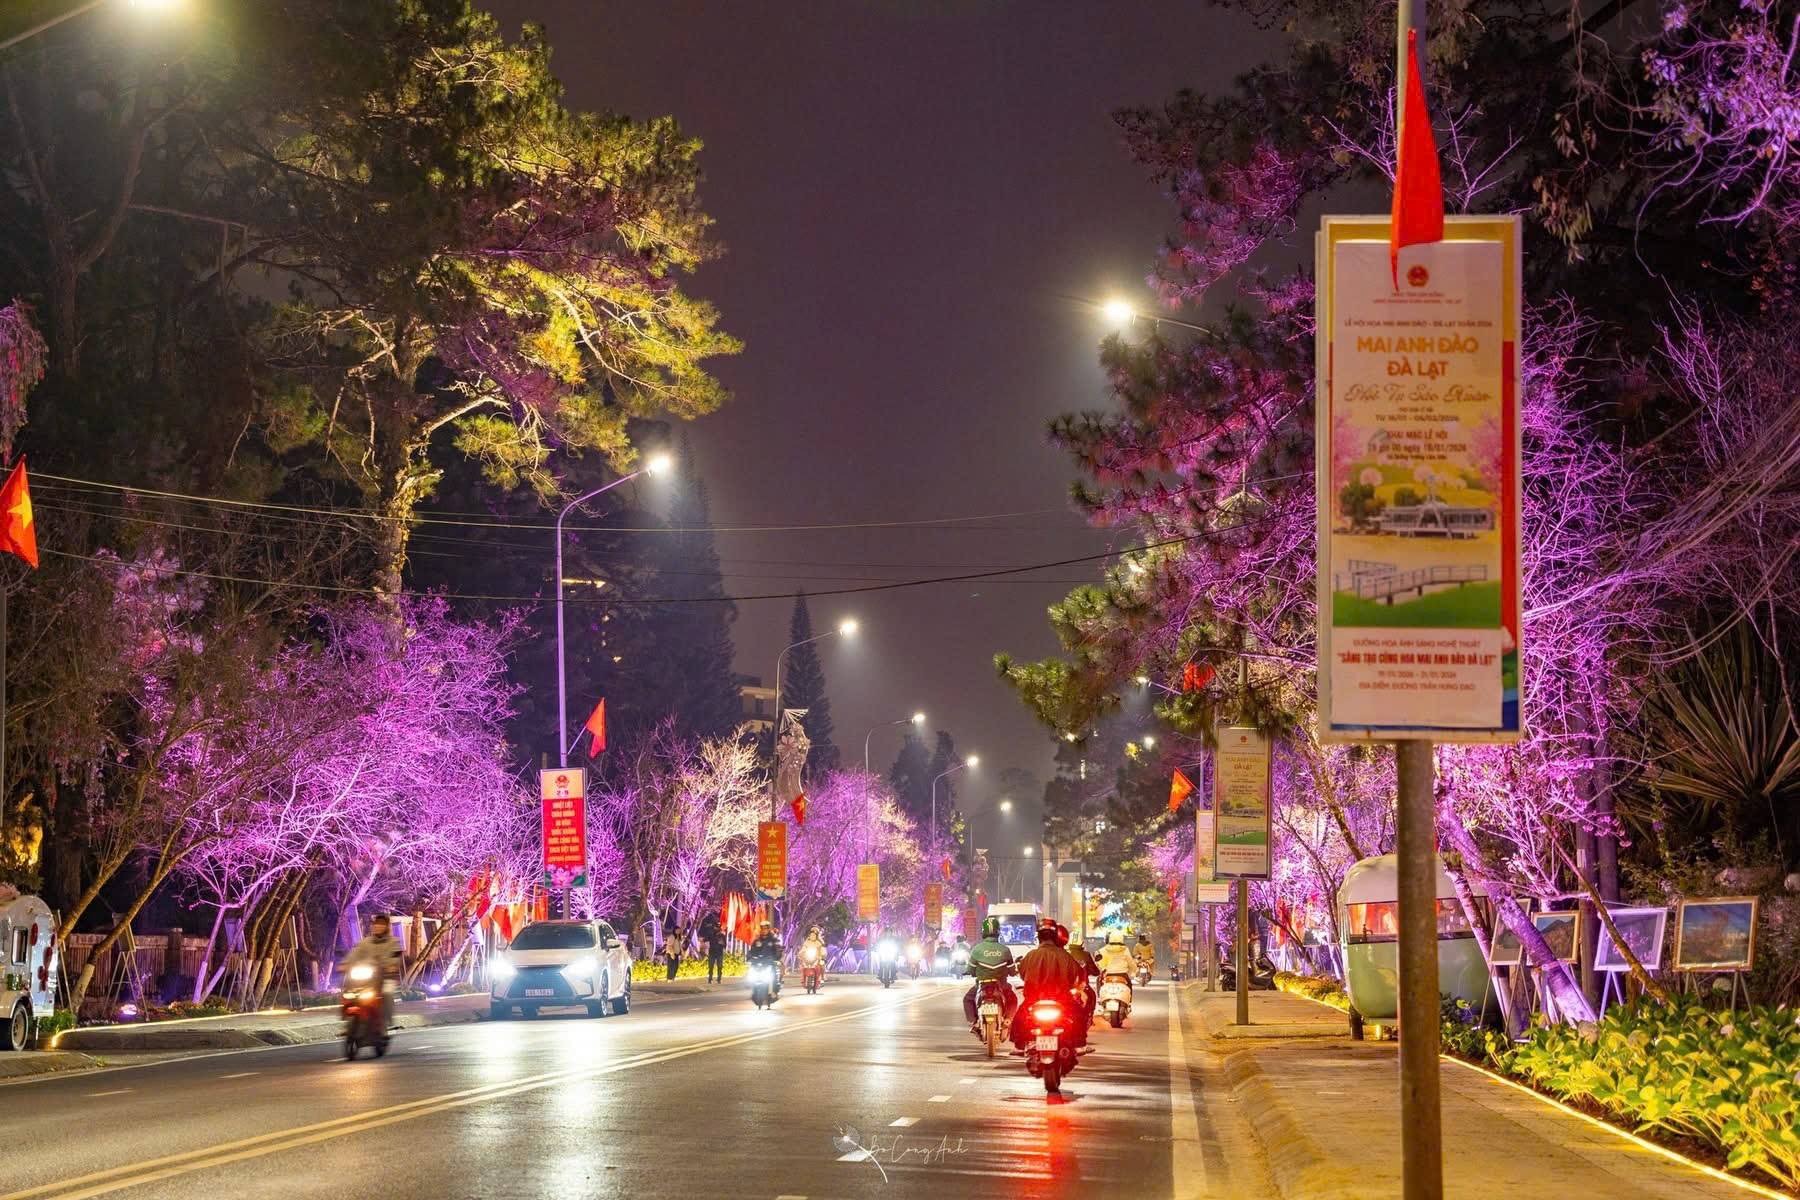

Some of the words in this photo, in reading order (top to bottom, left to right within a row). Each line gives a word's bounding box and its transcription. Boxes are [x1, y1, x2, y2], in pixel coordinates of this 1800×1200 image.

[1357, 336, 1391, 352] MAI
[1395, 336, 1434, 352] ANH
[1439, 331, 1479, 353] ĐÀO
[1387, 356, 1412, 376] ĐÀ
[1418, 361, 1449, 380] LẠT
[984, 950, 1002, 958] Grab
